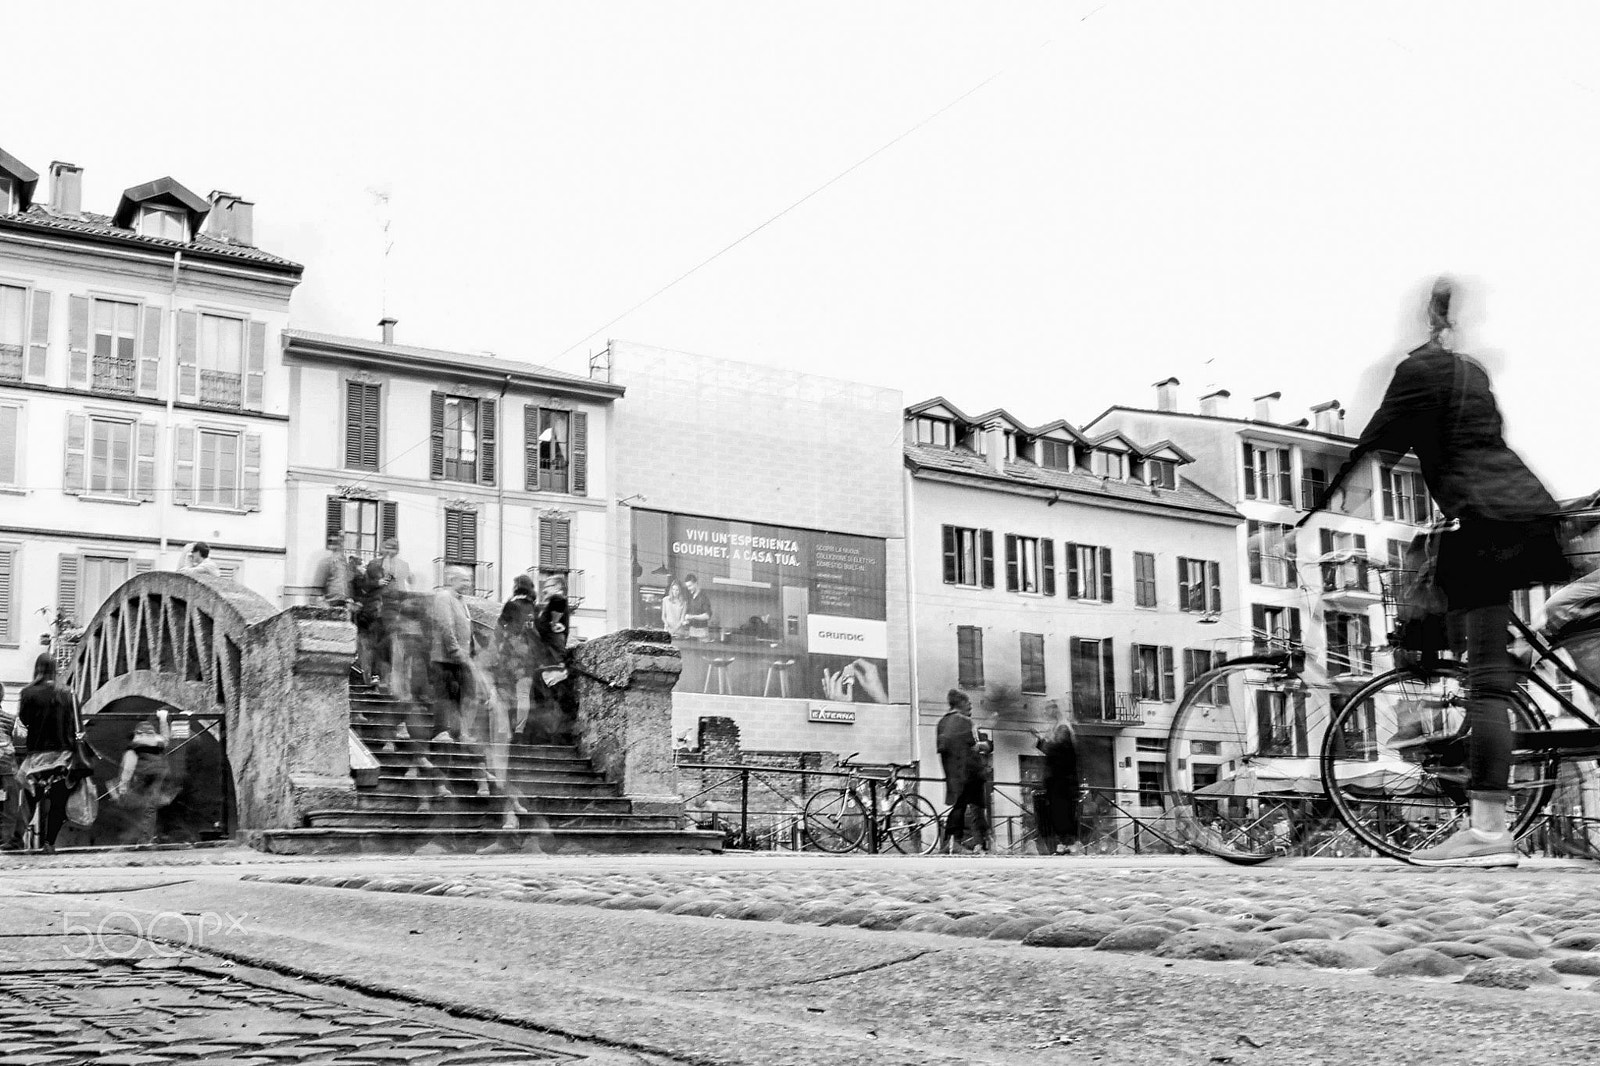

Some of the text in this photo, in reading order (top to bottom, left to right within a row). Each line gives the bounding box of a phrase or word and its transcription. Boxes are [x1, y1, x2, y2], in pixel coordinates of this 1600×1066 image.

[686, 529, 798, 552] VIVI UN'ESPERIENZA
[672, 541, 729, 559] GOURMET.
[732, 549, 741, 560] A
[743, 549, 773, 564] CASA
[818, 631, 864, 641] GRUNDIG
